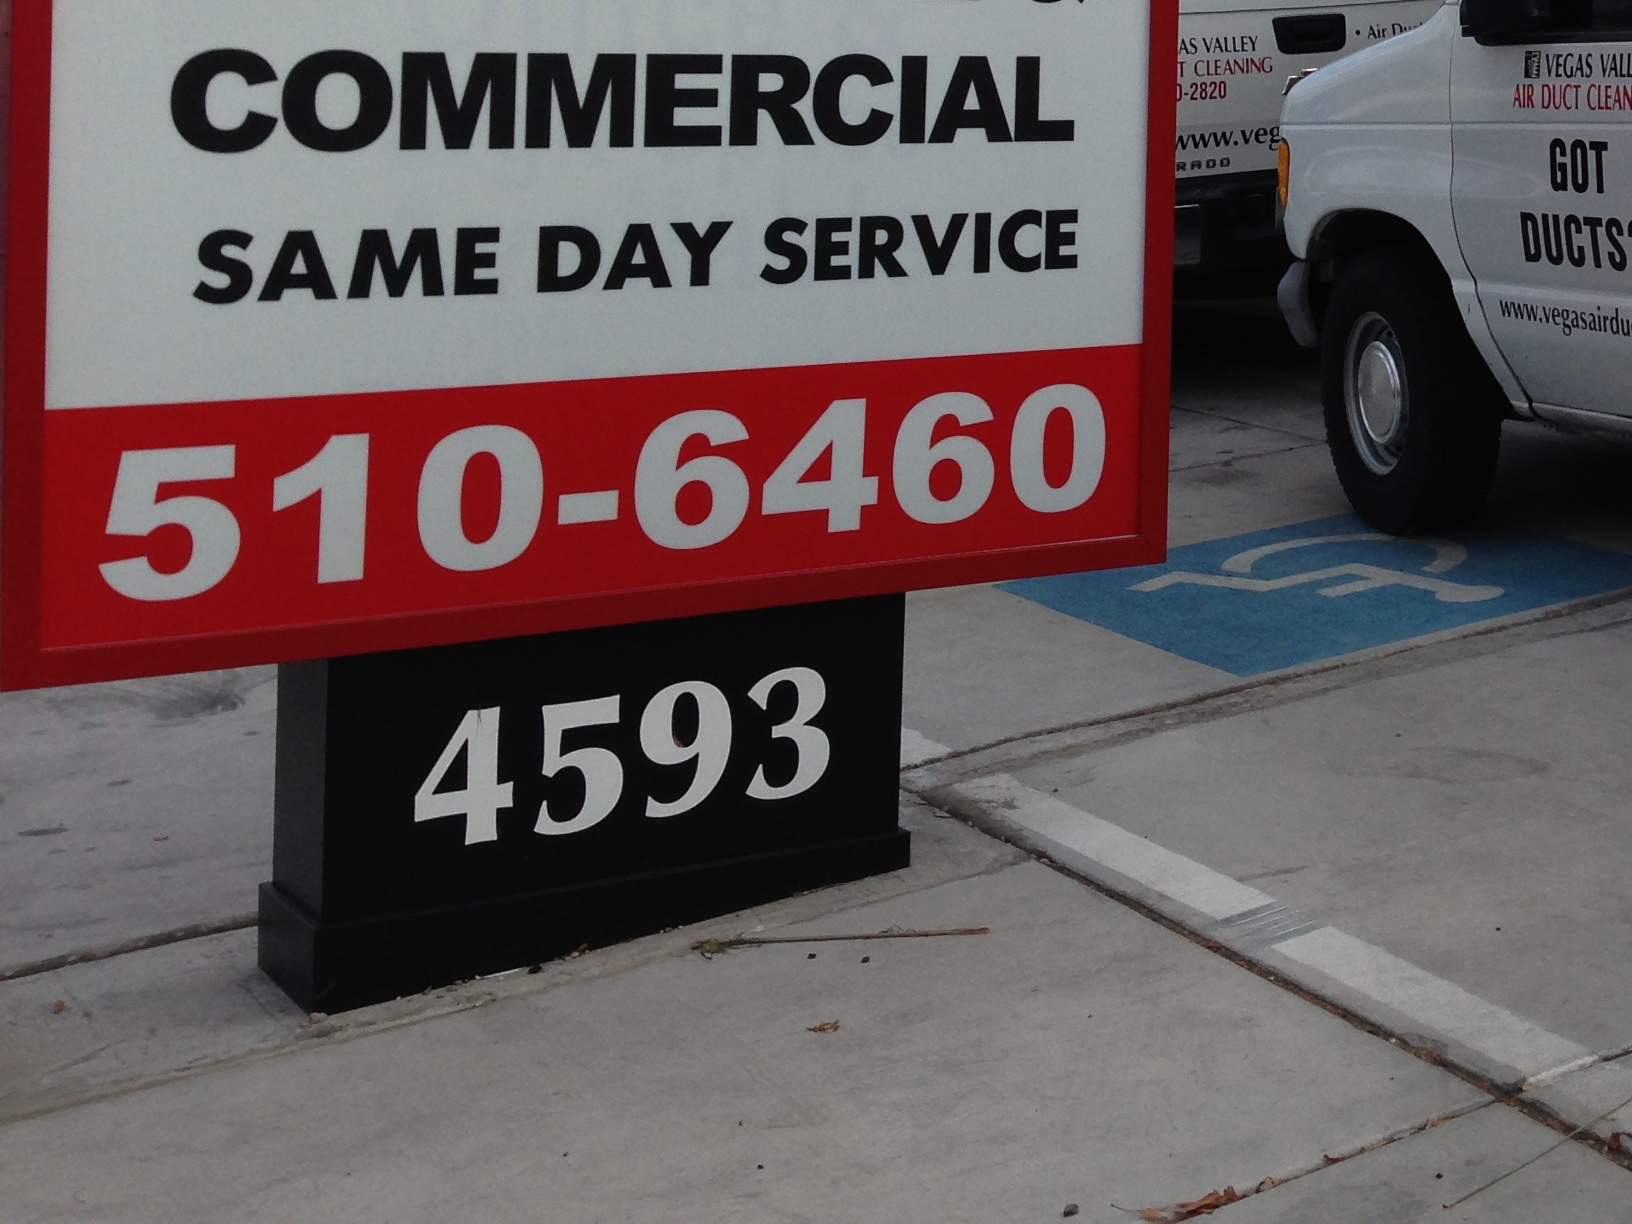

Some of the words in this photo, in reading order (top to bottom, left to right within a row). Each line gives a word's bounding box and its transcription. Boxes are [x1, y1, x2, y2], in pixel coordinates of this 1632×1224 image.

[1202, 35, 1259, 54] VALLEY
[1367, 23, 1388, 40] Air
[1193, 56, 1273, 76] CLEANING
[1545, 52, 1593, 79] VEGAS
[170, 47, 1075, 154] COMMERCIAL
[1513, 83, 1535, 110] AIR
[1541, 83, 1581, 111] DUCT
[1549, 137, 1608, 195] GOT
[192, 227, 500, 305] SAME
[536, 221, 734, 293] DAY
[760, 209, 1079, 285] SERVICE
[97, 382, 1108, 602] 510-6460
[413, 665, 833, 846] 4593
